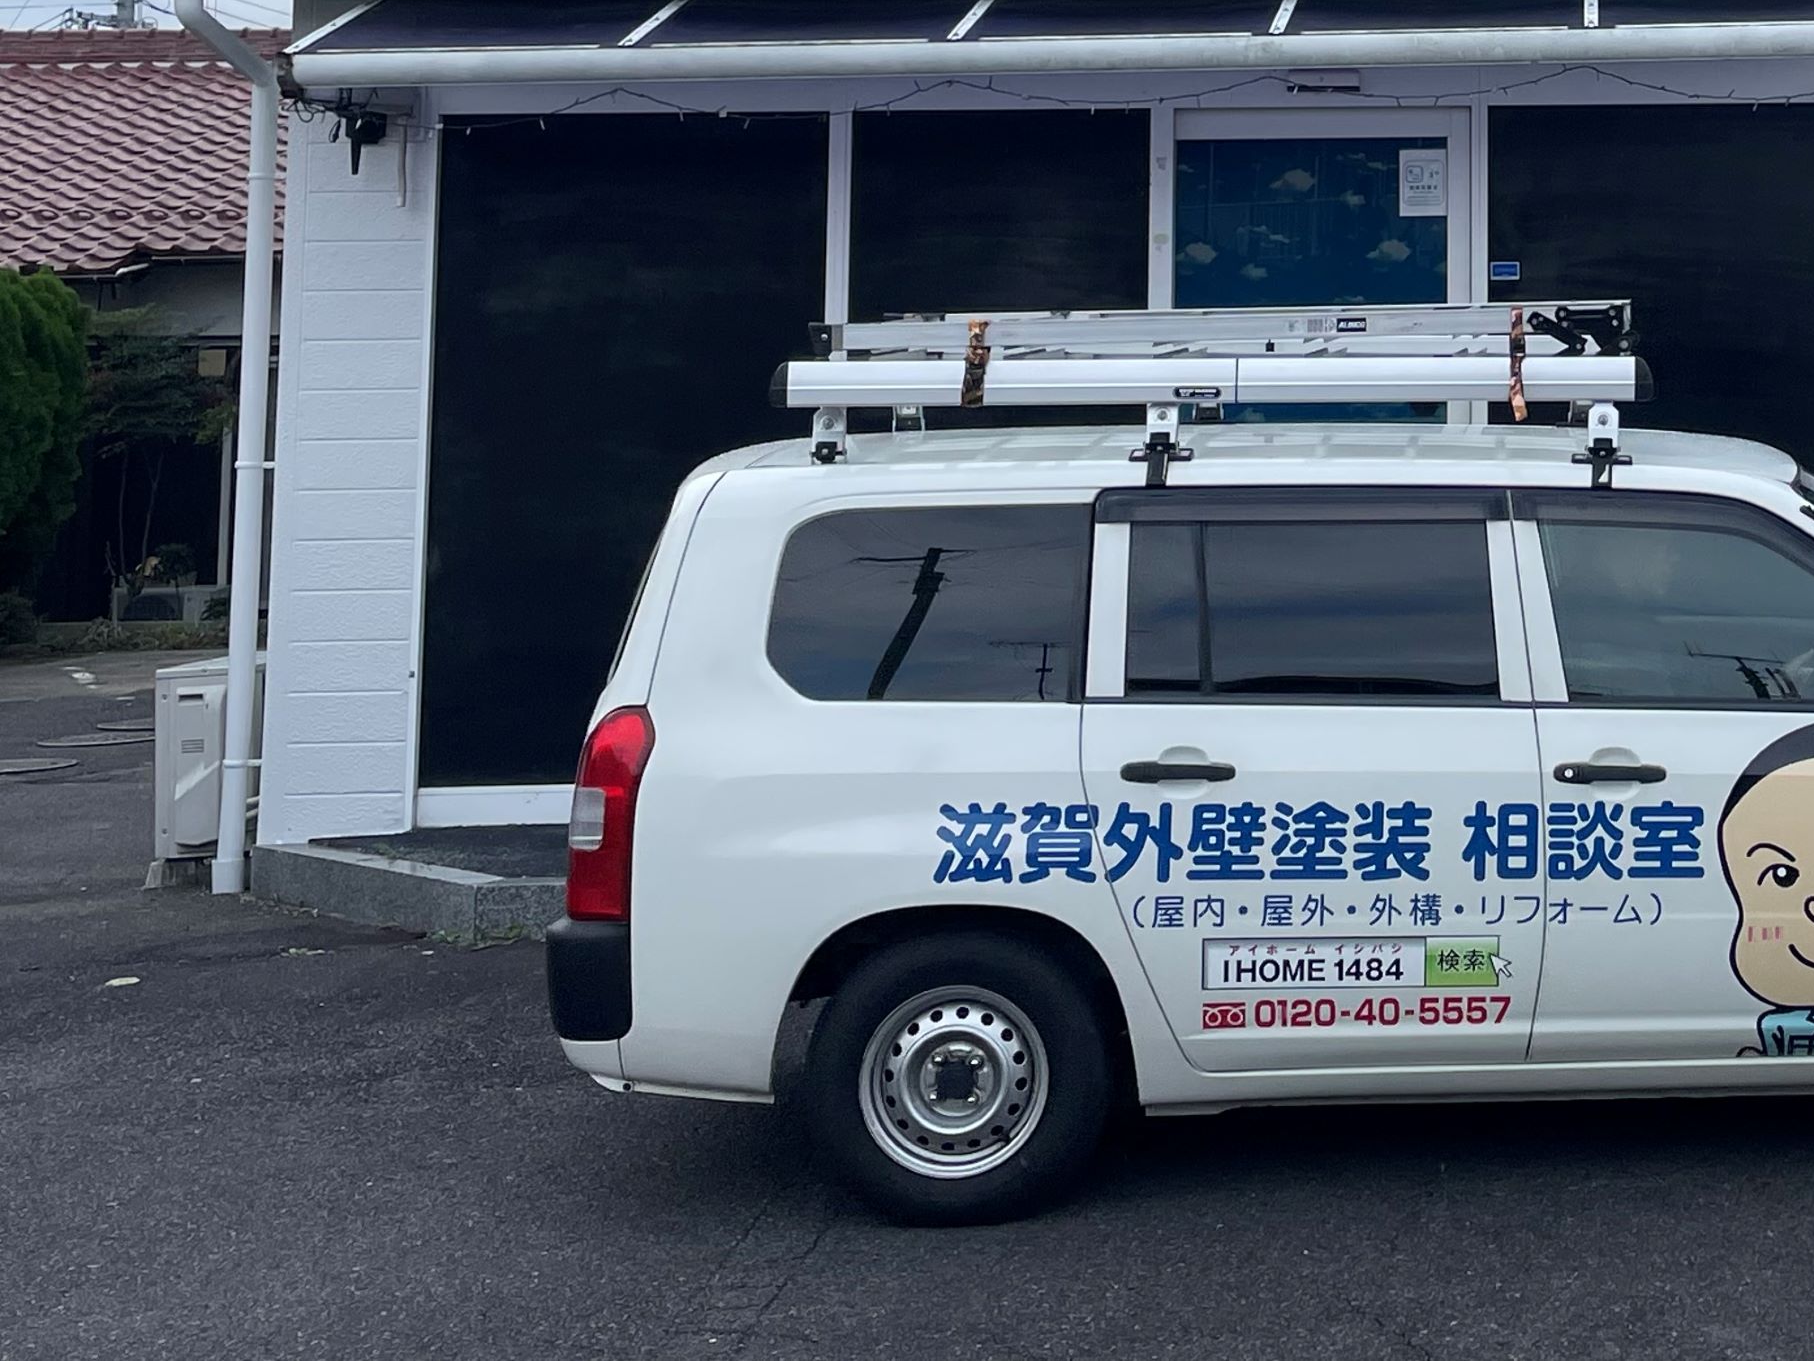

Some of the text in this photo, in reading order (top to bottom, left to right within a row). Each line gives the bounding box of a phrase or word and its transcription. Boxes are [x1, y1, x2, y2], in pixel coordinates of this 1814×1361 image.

[932, 799, 1706, 885] 滋賀外壁塗装 相談室
[1228, 943, 1316, 956] アイホーム
[1437, 948, 1486, 973] 検索
[1334, 958, 1404, 981] 1484
[1254, 995, 1512, 1027] 0120-40-5557
